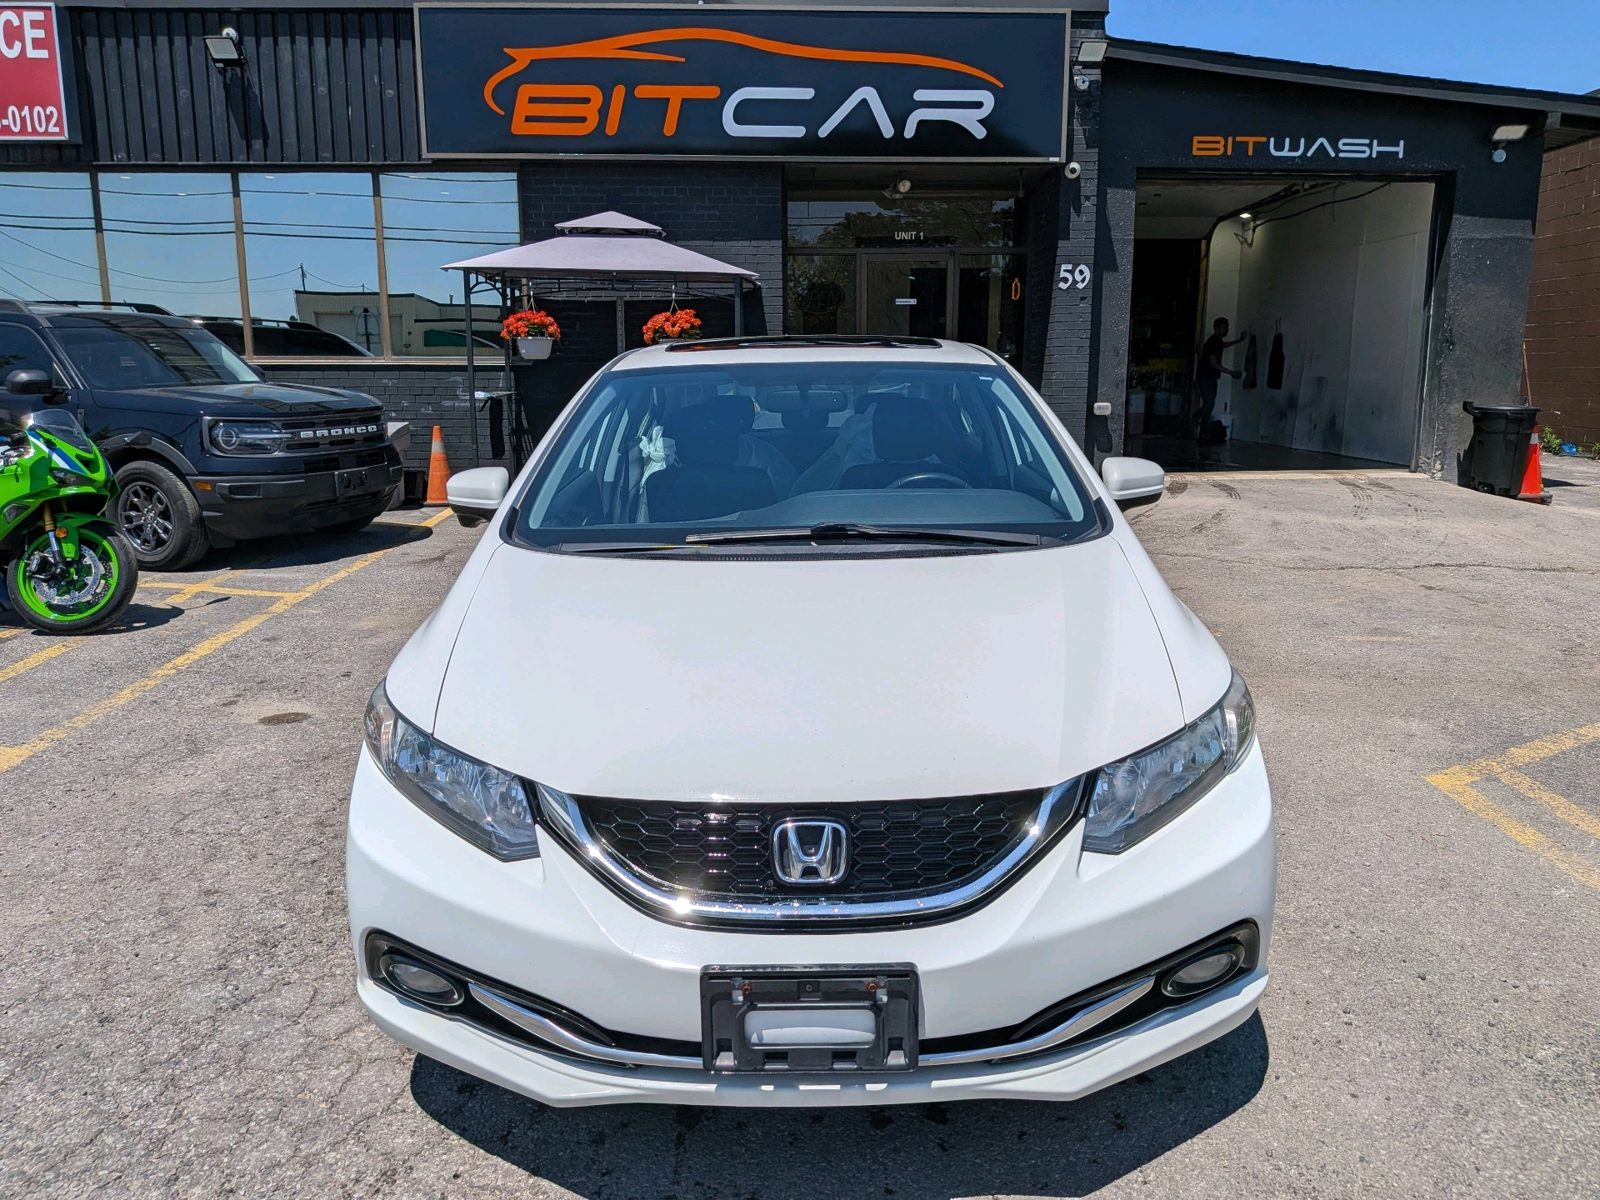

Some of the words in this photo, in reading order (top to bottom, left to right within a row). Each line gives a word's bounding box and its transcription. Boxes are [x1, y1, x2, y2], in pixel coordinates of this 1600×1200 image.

[510, 84, 995, 140] BITCAR
[1191, 135, 1405, 159] BITWASH
[894, 231, 917, 240] UNIT
[919, 231, 924, 240] 1
[1058, 263, 1091, 290] 59
[300, 425, 377, 439] BRONCO
